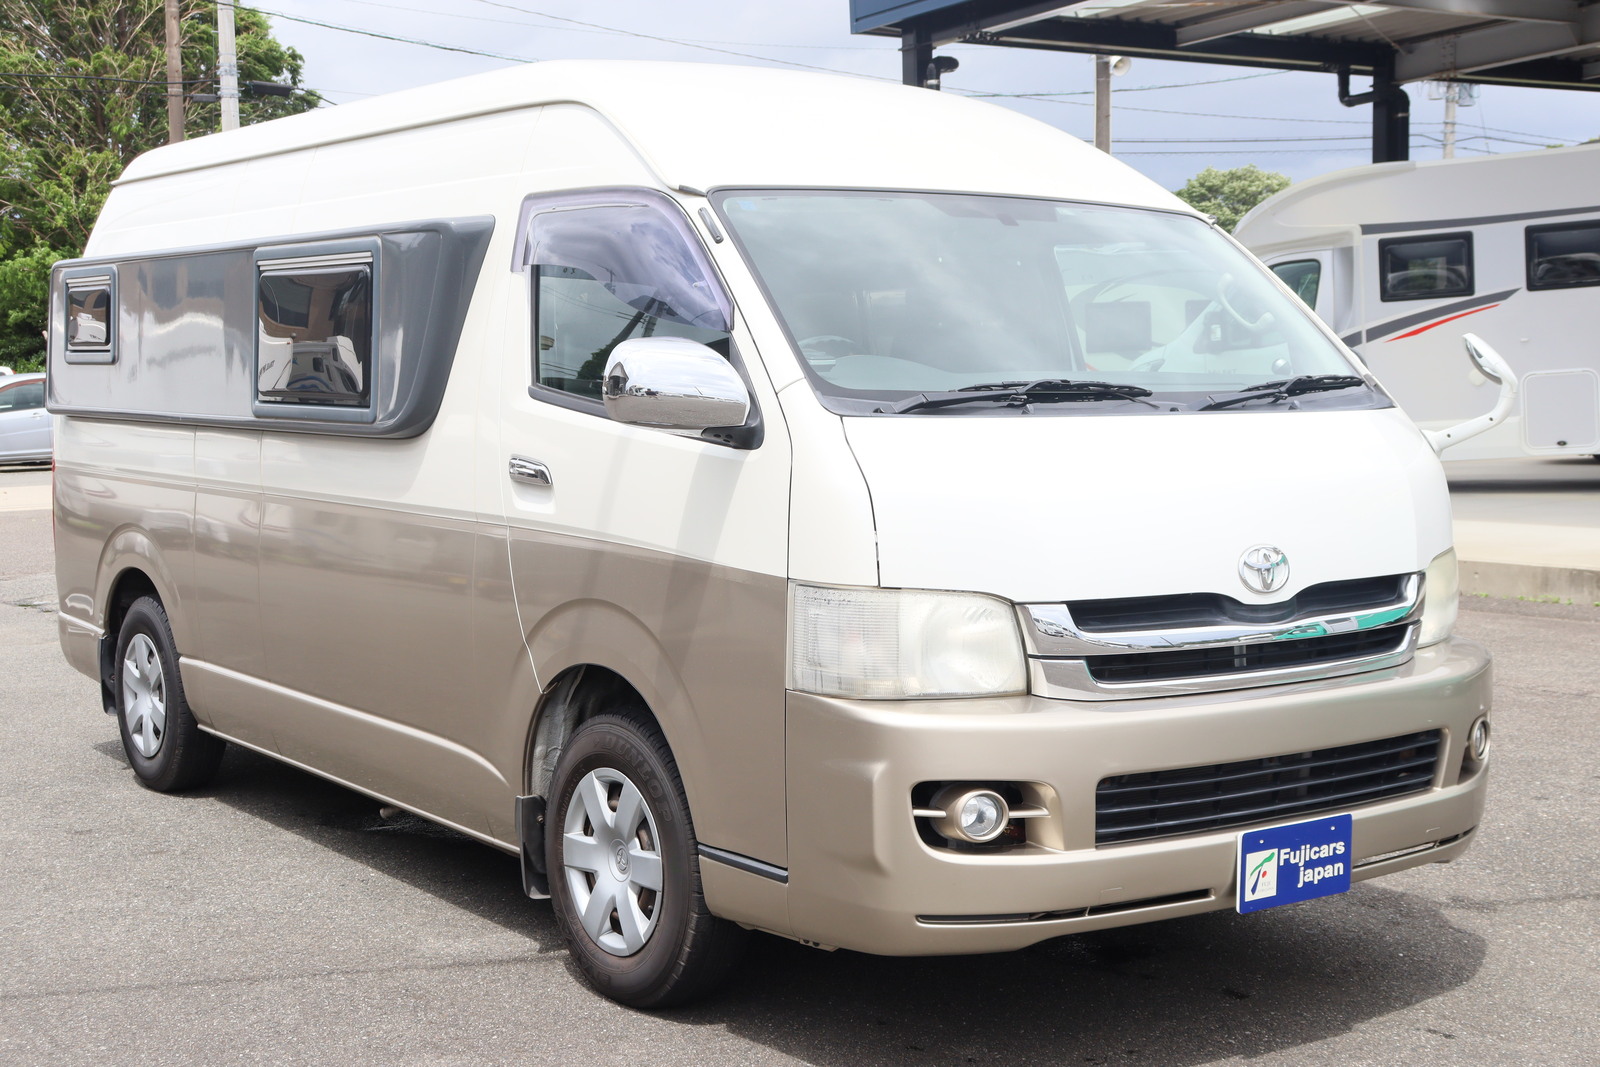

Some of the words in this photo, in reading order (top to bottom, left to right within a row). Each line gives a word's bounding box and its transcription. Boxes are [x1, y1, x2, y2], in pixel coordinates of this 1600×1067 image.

[601, 735, 673, 822] DUNLOP
[1279, 841, 1345, 866] Fujicars
[1297, 862, 1344, 888] japan
